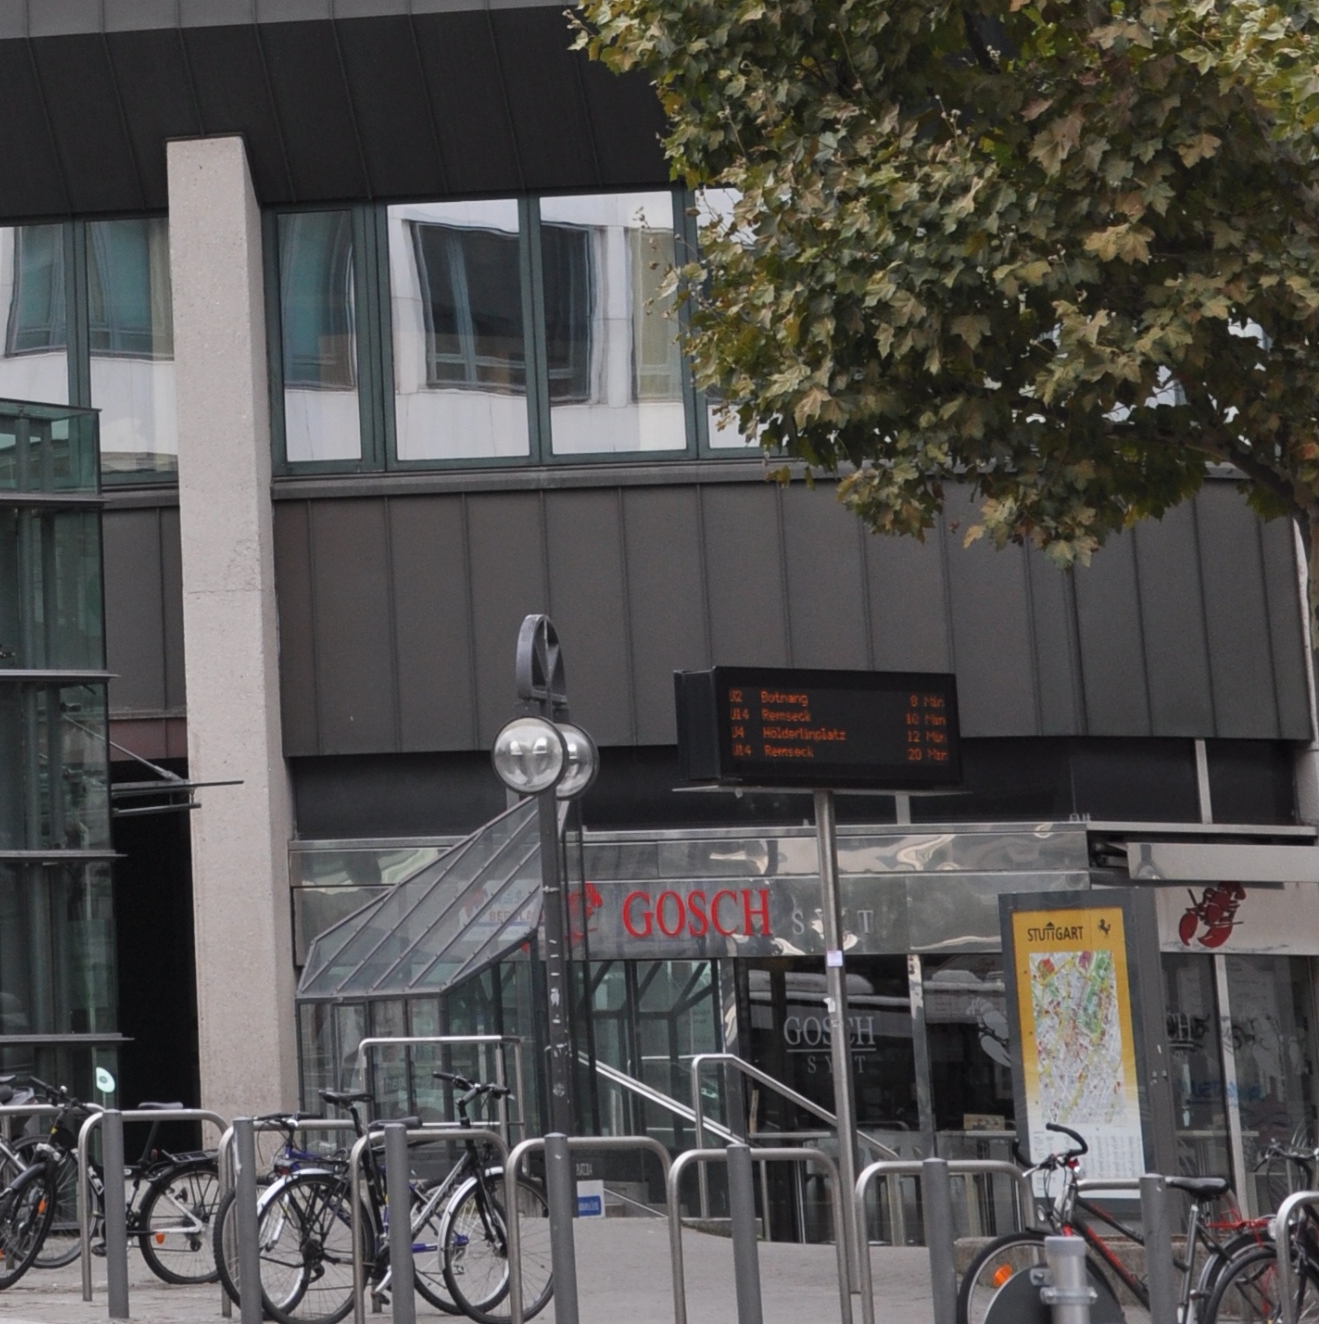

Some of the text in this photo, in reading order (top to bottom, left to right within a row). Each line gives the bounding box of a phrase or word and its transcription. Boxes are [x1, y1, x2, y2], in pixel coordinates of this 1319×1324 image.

[761, 691, 809, 707] Botnang
[762, 709, 812, 722] Remseck
[622, 887, 773, 939] GOSCH
